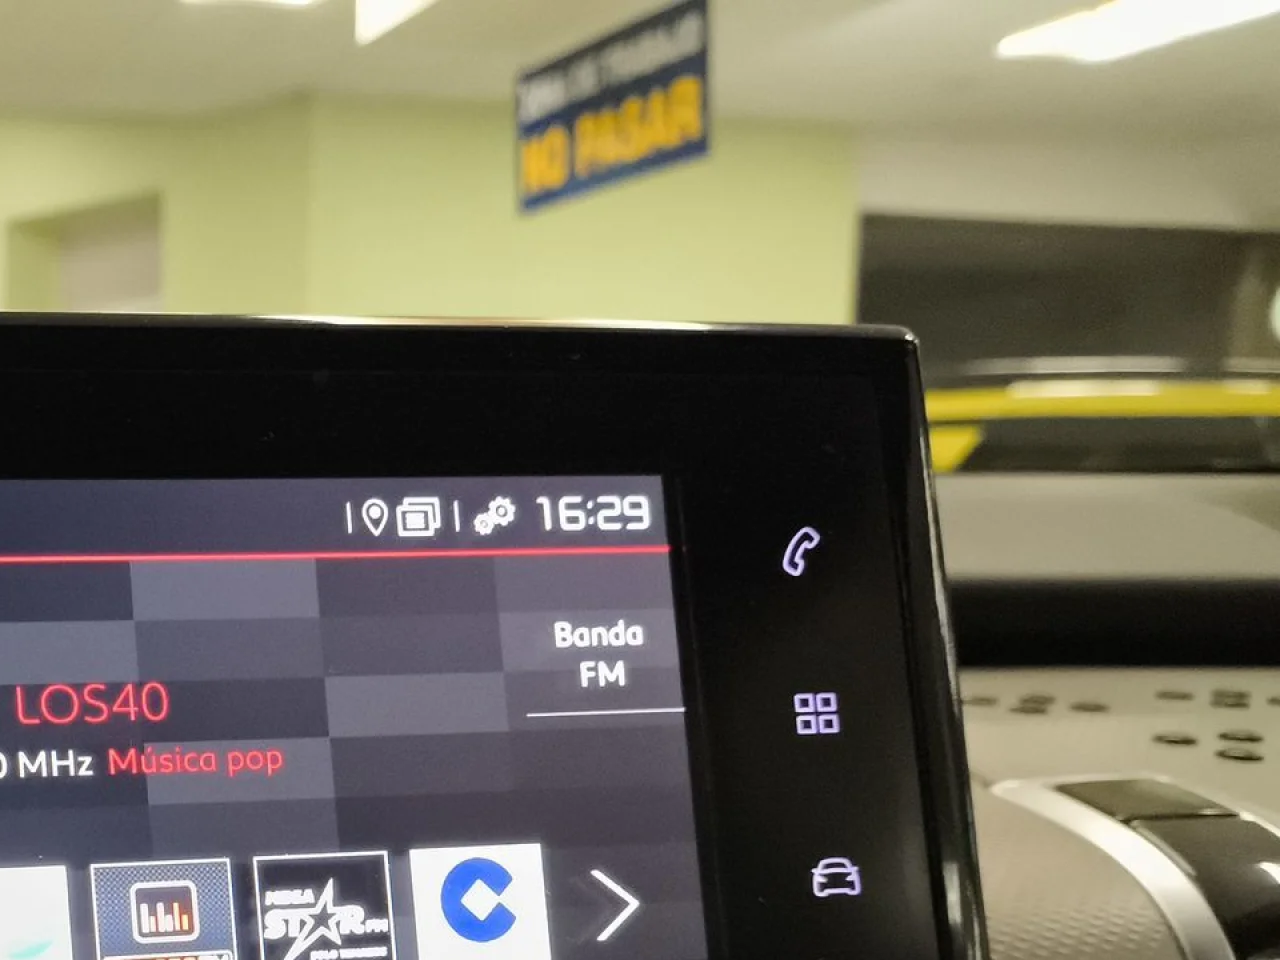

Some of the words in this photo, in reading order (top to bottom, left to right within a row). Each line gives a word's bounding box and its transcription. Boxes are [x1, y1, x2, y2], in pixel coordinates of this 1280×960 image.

[535, 495, 651, 532] 16:29
[554, 619, 644, 649] Banda
[579, 659, 626, 688] FM
[15, 681, 169, 726] LOS40
[17, 748, 94, 779] MHz
[108, 746, 218, 776] Música
[227, 749, 283, 777] pop
